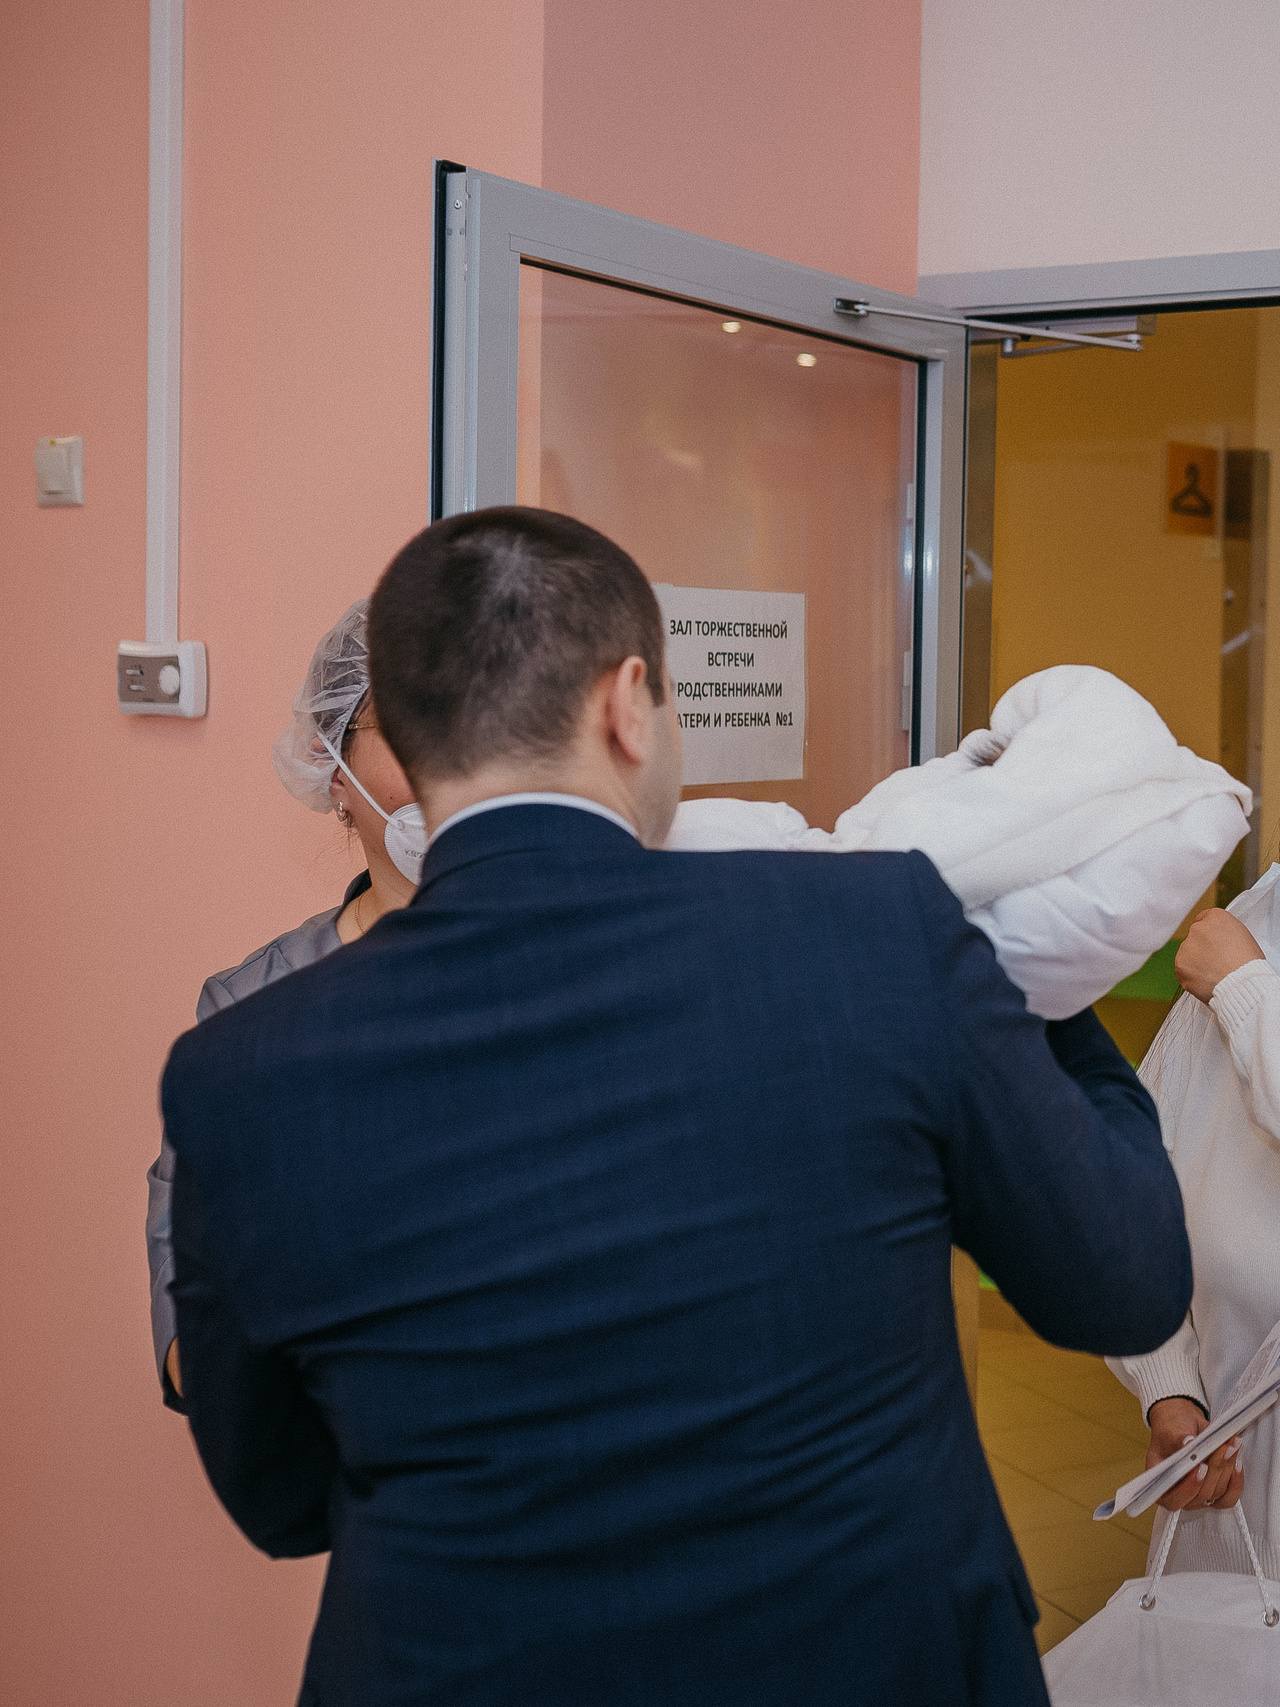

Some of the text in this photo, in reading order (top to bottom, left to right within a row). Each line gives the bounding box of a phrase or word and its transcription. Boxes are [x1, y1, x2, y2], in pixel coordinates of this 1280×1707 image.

[669, 619, 788, 639] ЗАЛ ТОРЖЕСТВЕННОЙ
[707, 652, 755, 667] ВСТРЕЧИ
[677, 682, 783, 701] РОДСТВЕННИКАМИ
[677, 711, 793, 729] АТЕРИ И РЕБЕНКА №1
